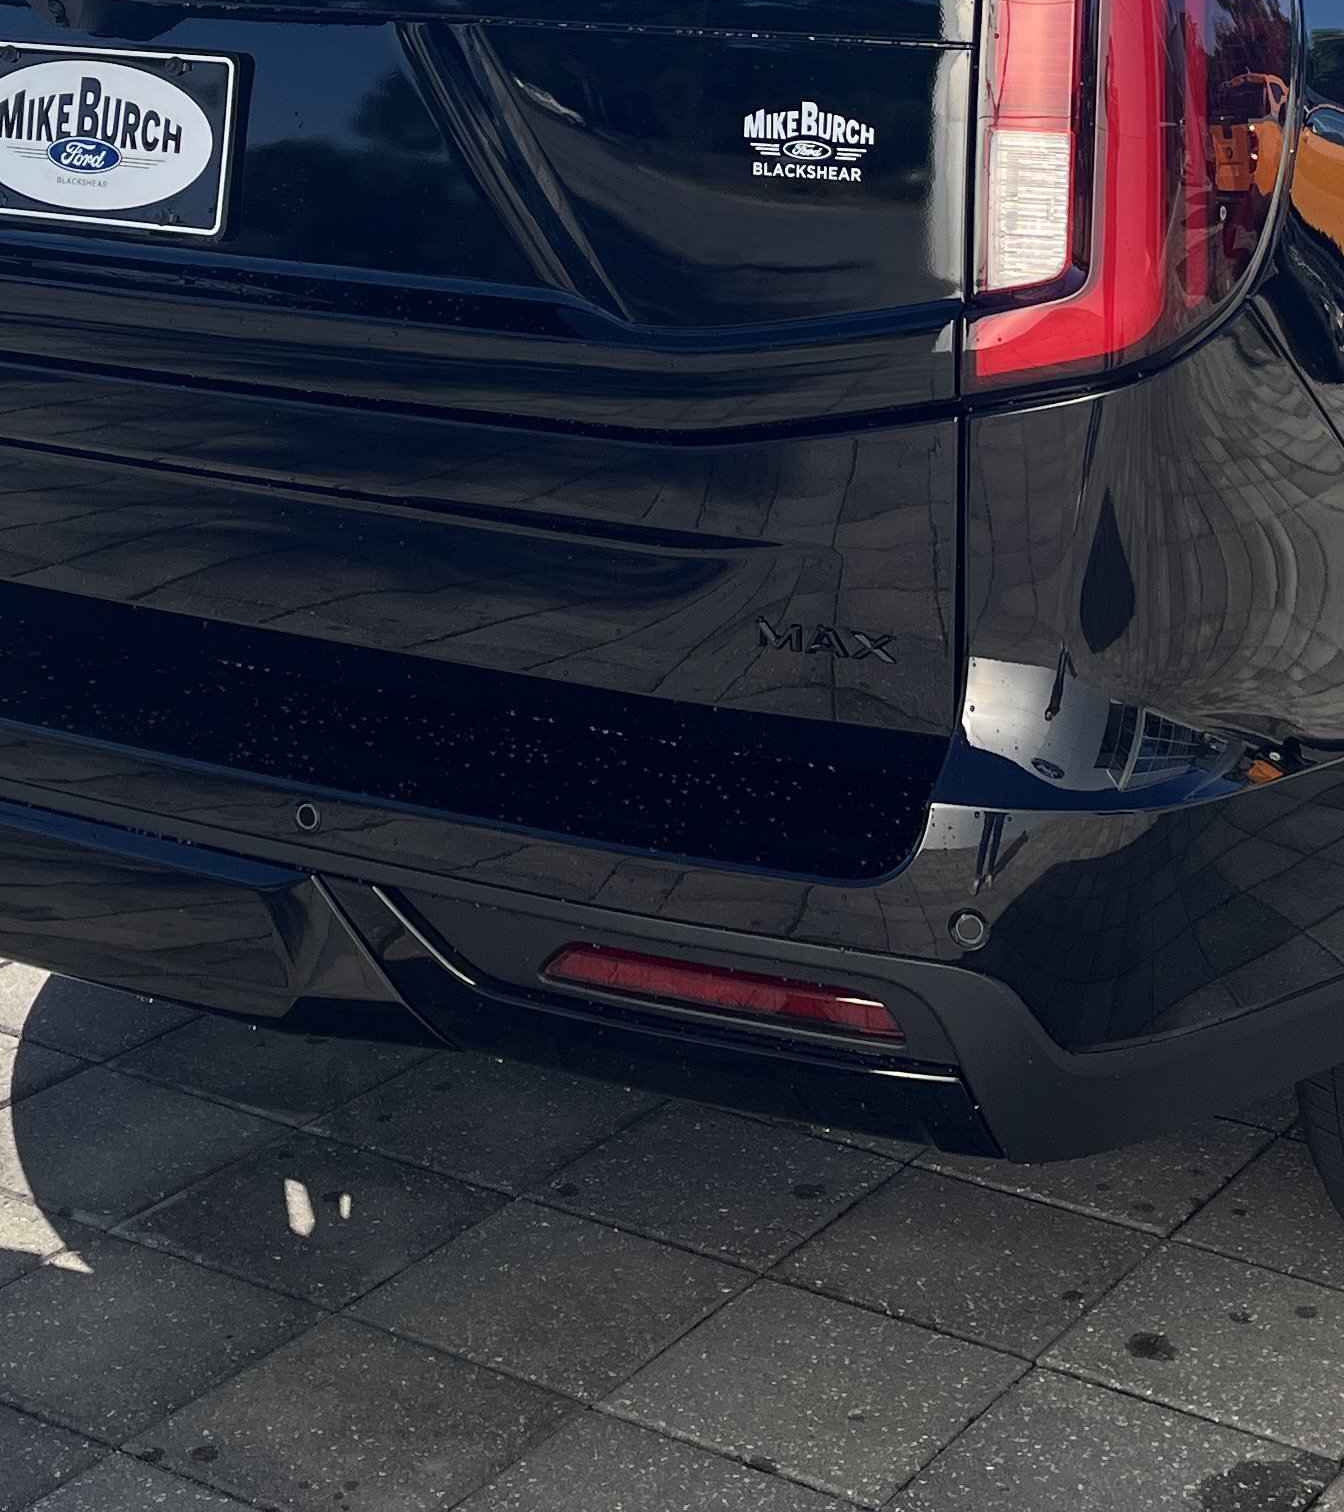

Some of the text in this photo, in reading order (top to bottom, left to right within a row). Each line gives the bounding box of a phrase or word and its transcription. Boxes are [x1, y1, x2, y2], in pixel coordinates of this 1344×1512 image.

[59, 141, 107, 168] Ford
[791, 143, 823, 157] Ford
[56, 175, 108, 188] BLACKSHEAR
[752, 161, 862, 182] BLACKSHEAR
[756, 615, 898, 665] MAX
